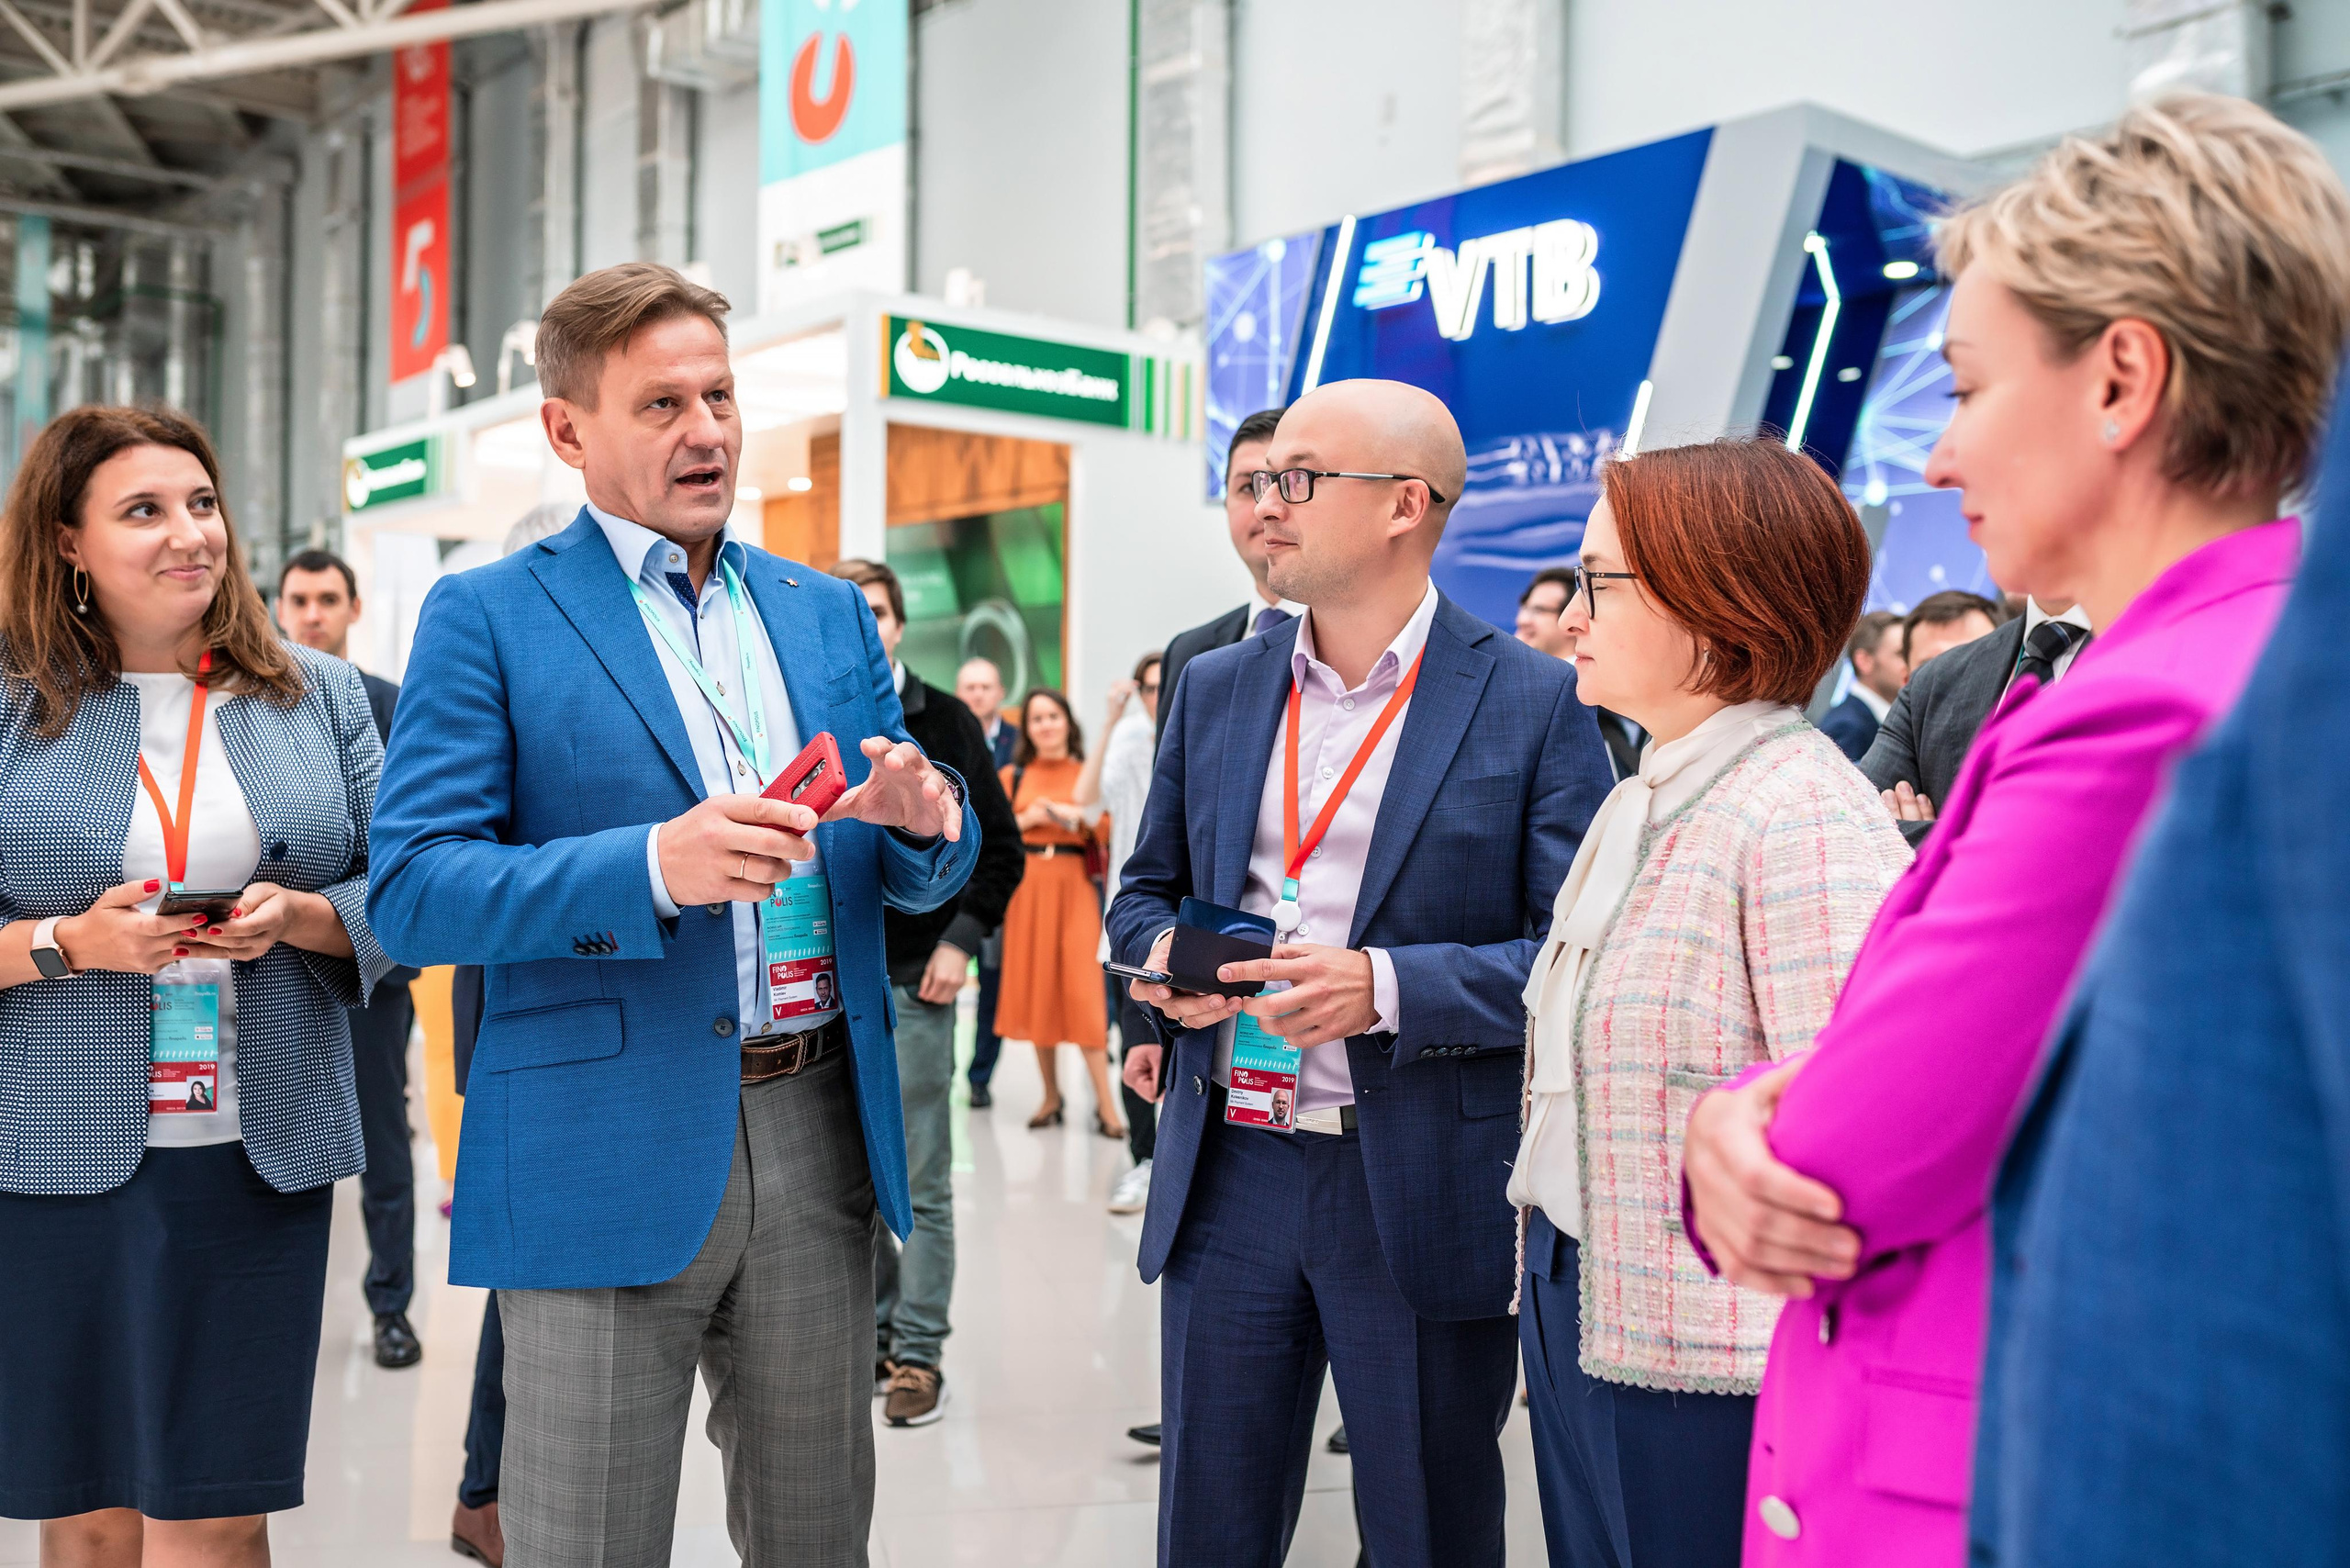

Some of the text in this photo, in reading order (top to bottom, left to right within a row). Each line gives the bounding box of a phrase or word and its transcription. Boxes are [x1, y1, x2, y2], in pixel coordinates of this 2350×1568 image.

[1426, 218, 1601, 342] VTB
[772, 965, 788, 974] FINO
[778, 970, 794, 980] POLIS
[150, 1001, 173, 1011] OLIS
[775, 1006, 782, 1016] V
[1234, 1070, 1248, 1078] FINO
[1237, 1077, 1254, 1085] POLIS
[1230, 1108, 1237, 1118] V
